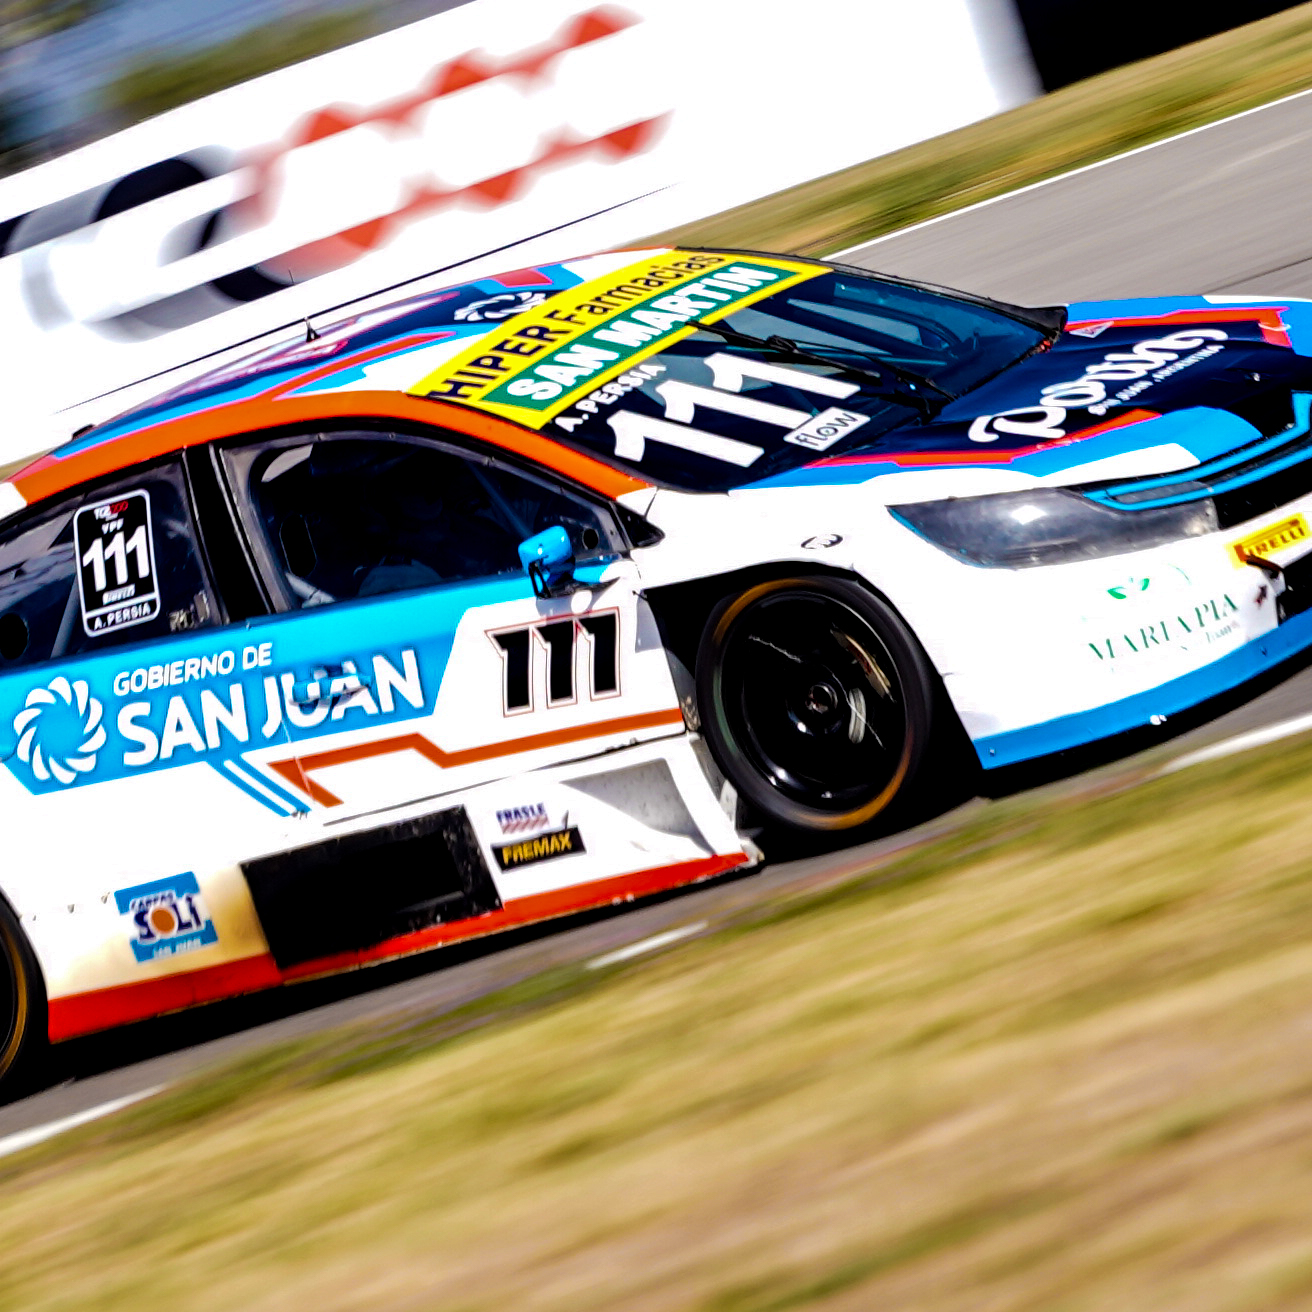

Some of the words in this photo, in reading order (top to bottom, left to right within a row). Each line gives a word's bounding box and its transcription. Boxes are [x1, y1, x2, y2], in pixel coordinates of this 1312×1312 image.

[427, 322, 572, 401] HIPER
[545, 255, 726, 326] Farmacias
[507, 341, 619, 400] SAN
[593, 266, 779, 348] MARTIN
[607, 352, 861, 467] 111
[82, 525, 150, 592] 111
[113, 650, 235, 696] GOBIERNO
[242, 642, 273, 671] DE
[117, 682, 249, 767] SAN
[261, 649, 425, 740] JUAN
[484, 608, 620, 717] 111
[502, 830, 572, 866] FREMAX
